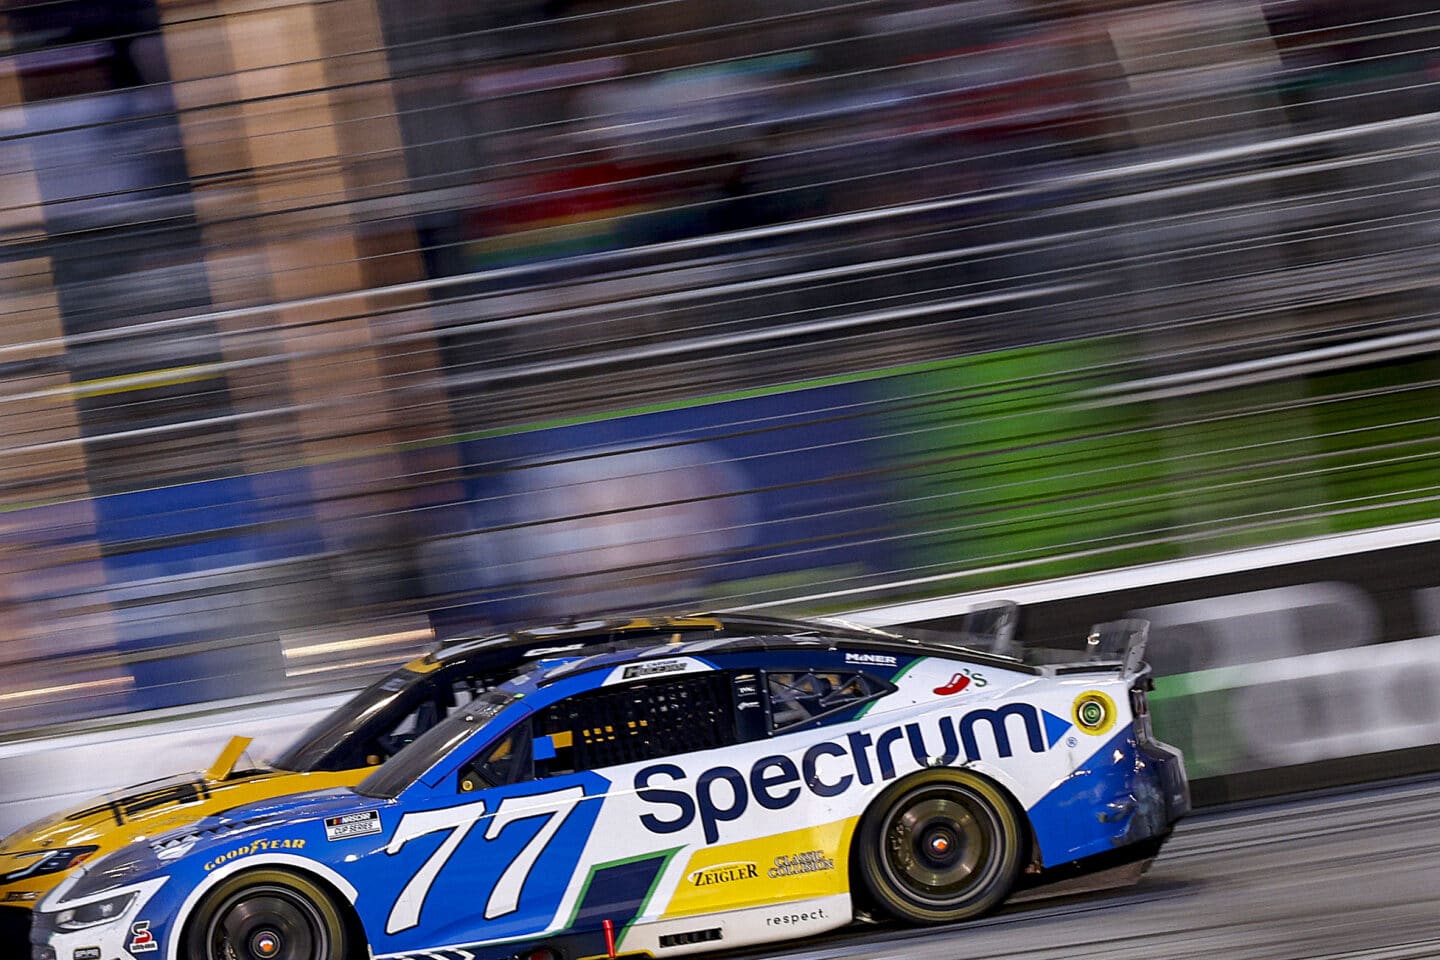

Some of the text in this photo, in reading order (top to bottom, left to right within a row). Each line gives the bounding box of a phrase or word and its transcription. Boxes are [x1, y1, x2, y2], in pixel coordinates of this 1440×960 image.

[633, 702, 1046, 844] Spectrum
[203, 838, 307, 871] GOODYEAR
[384, 786, 585, 936] 77
[694, 864, 758, 886] ZEIGLER
